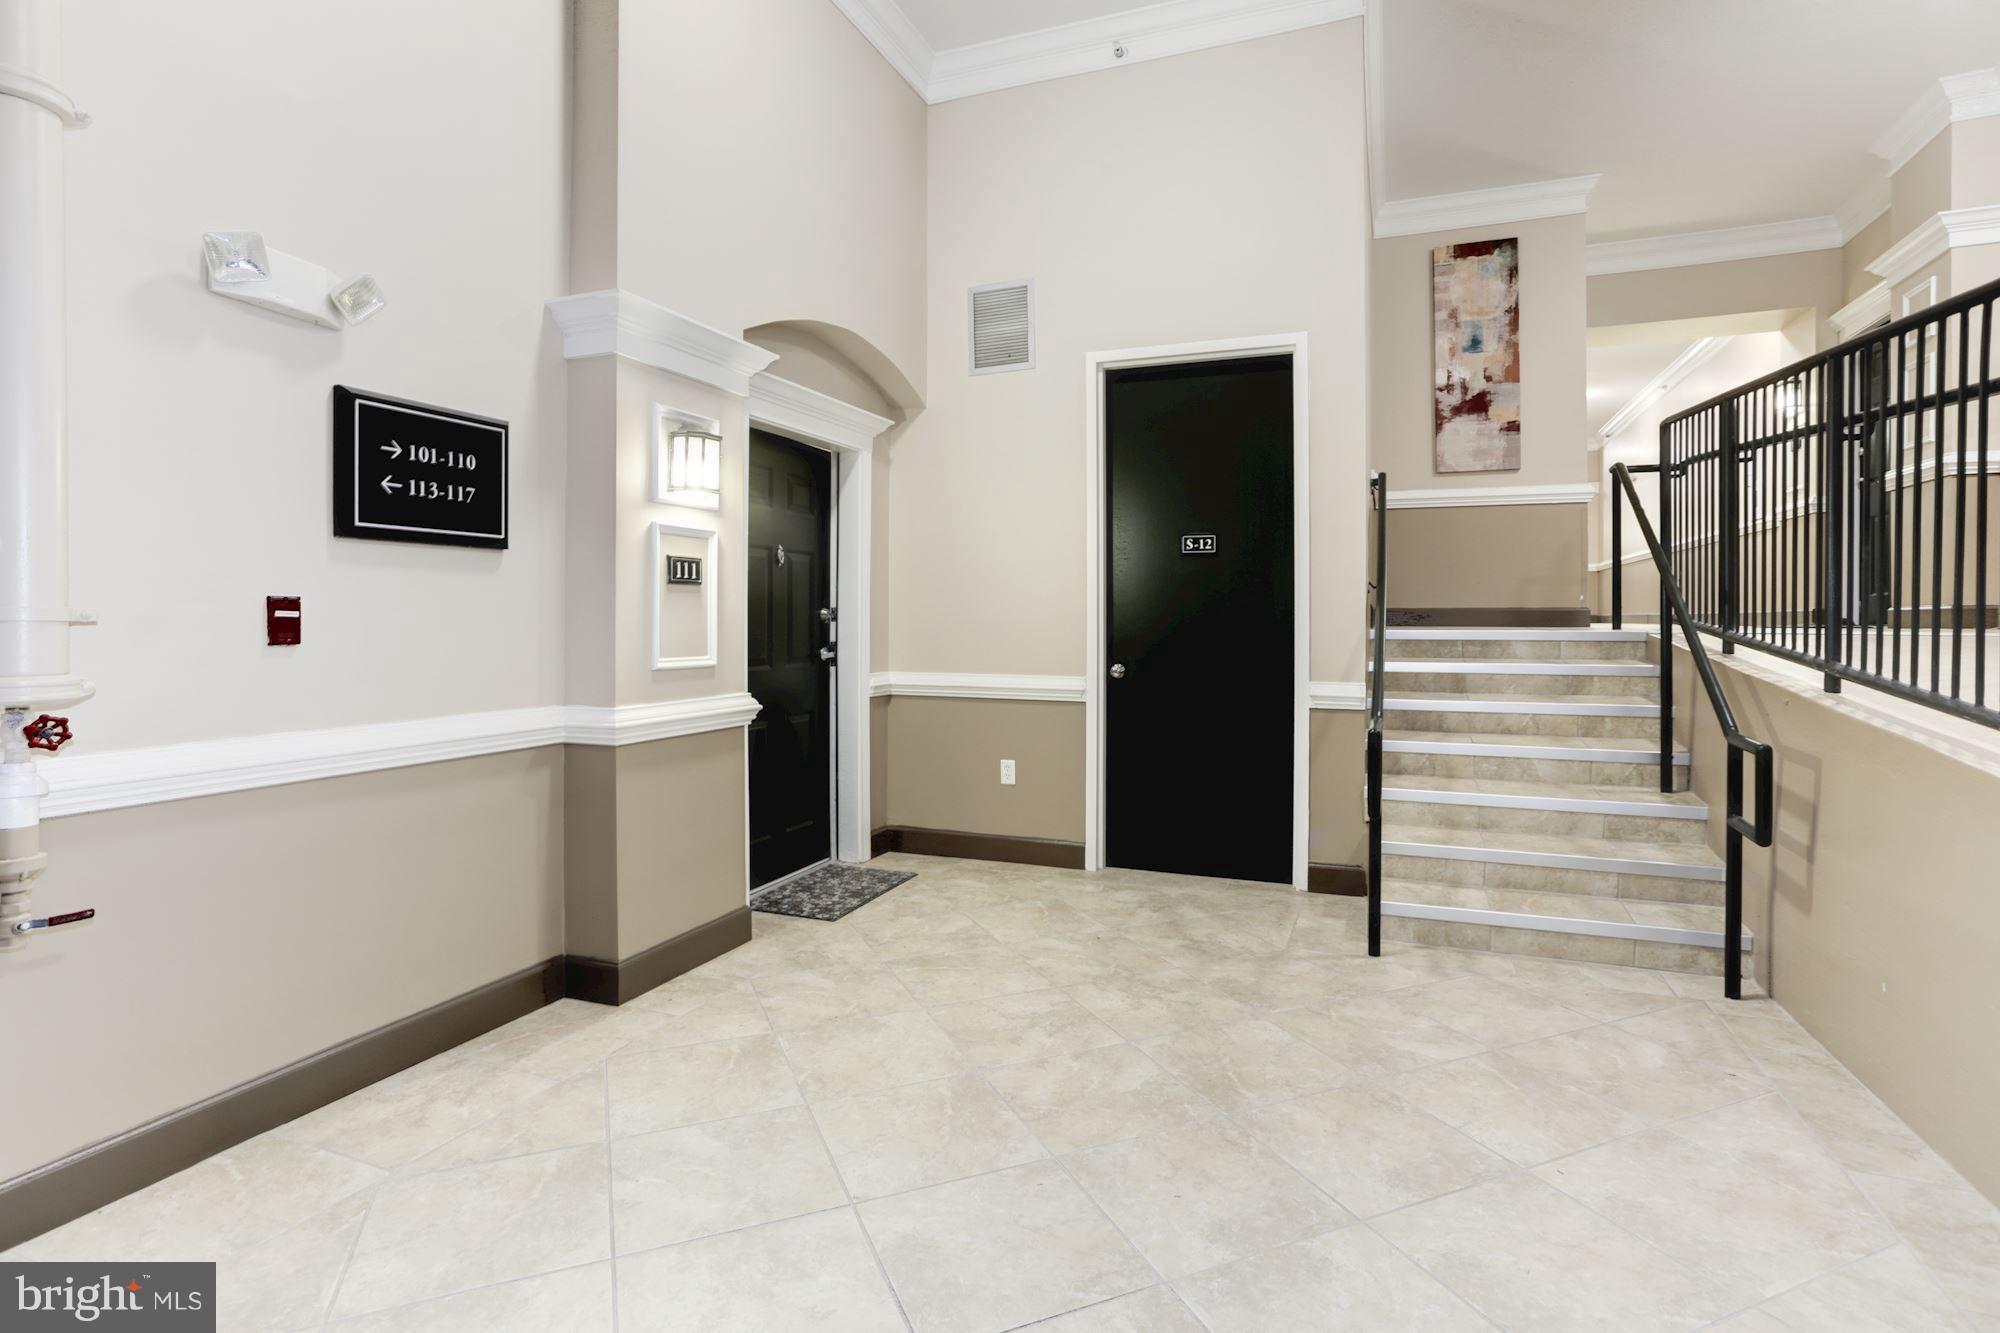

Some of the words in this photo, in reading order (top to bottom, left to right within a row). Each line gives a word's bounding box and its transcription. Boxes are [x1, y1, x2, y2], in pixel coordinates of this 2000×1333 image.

[408, 444, 476, 471] 101-110
[408, 479, 476, 504] 113-117
[1186, 538, 1212, 550] S-12
[676, 561, 697, 580] 111
